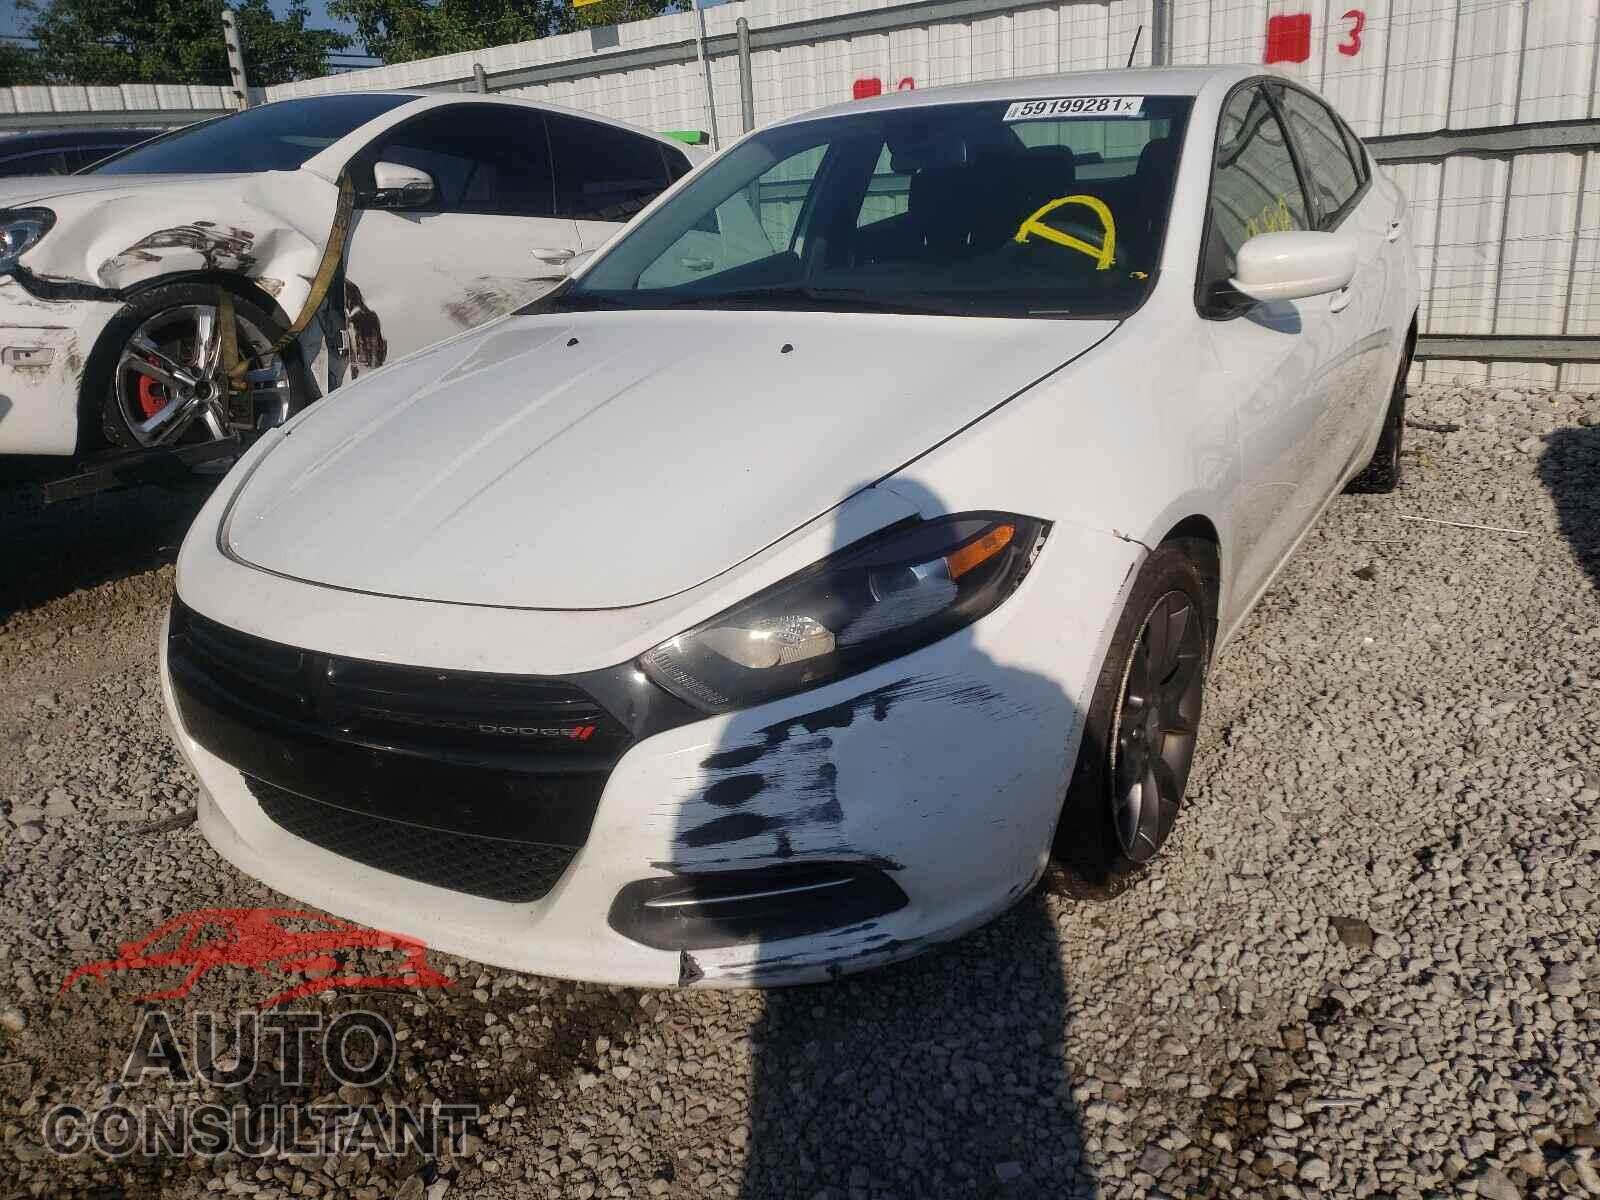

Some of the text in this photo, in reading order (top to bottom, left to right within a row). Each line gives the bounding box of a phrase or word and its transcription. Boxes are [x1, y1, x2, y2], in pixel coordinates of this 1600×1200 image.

[1338, 10, 1365, 56] 3
[1021, 98, 1122, 116] 59199281
[479, 724, 577, 737] DODGE
